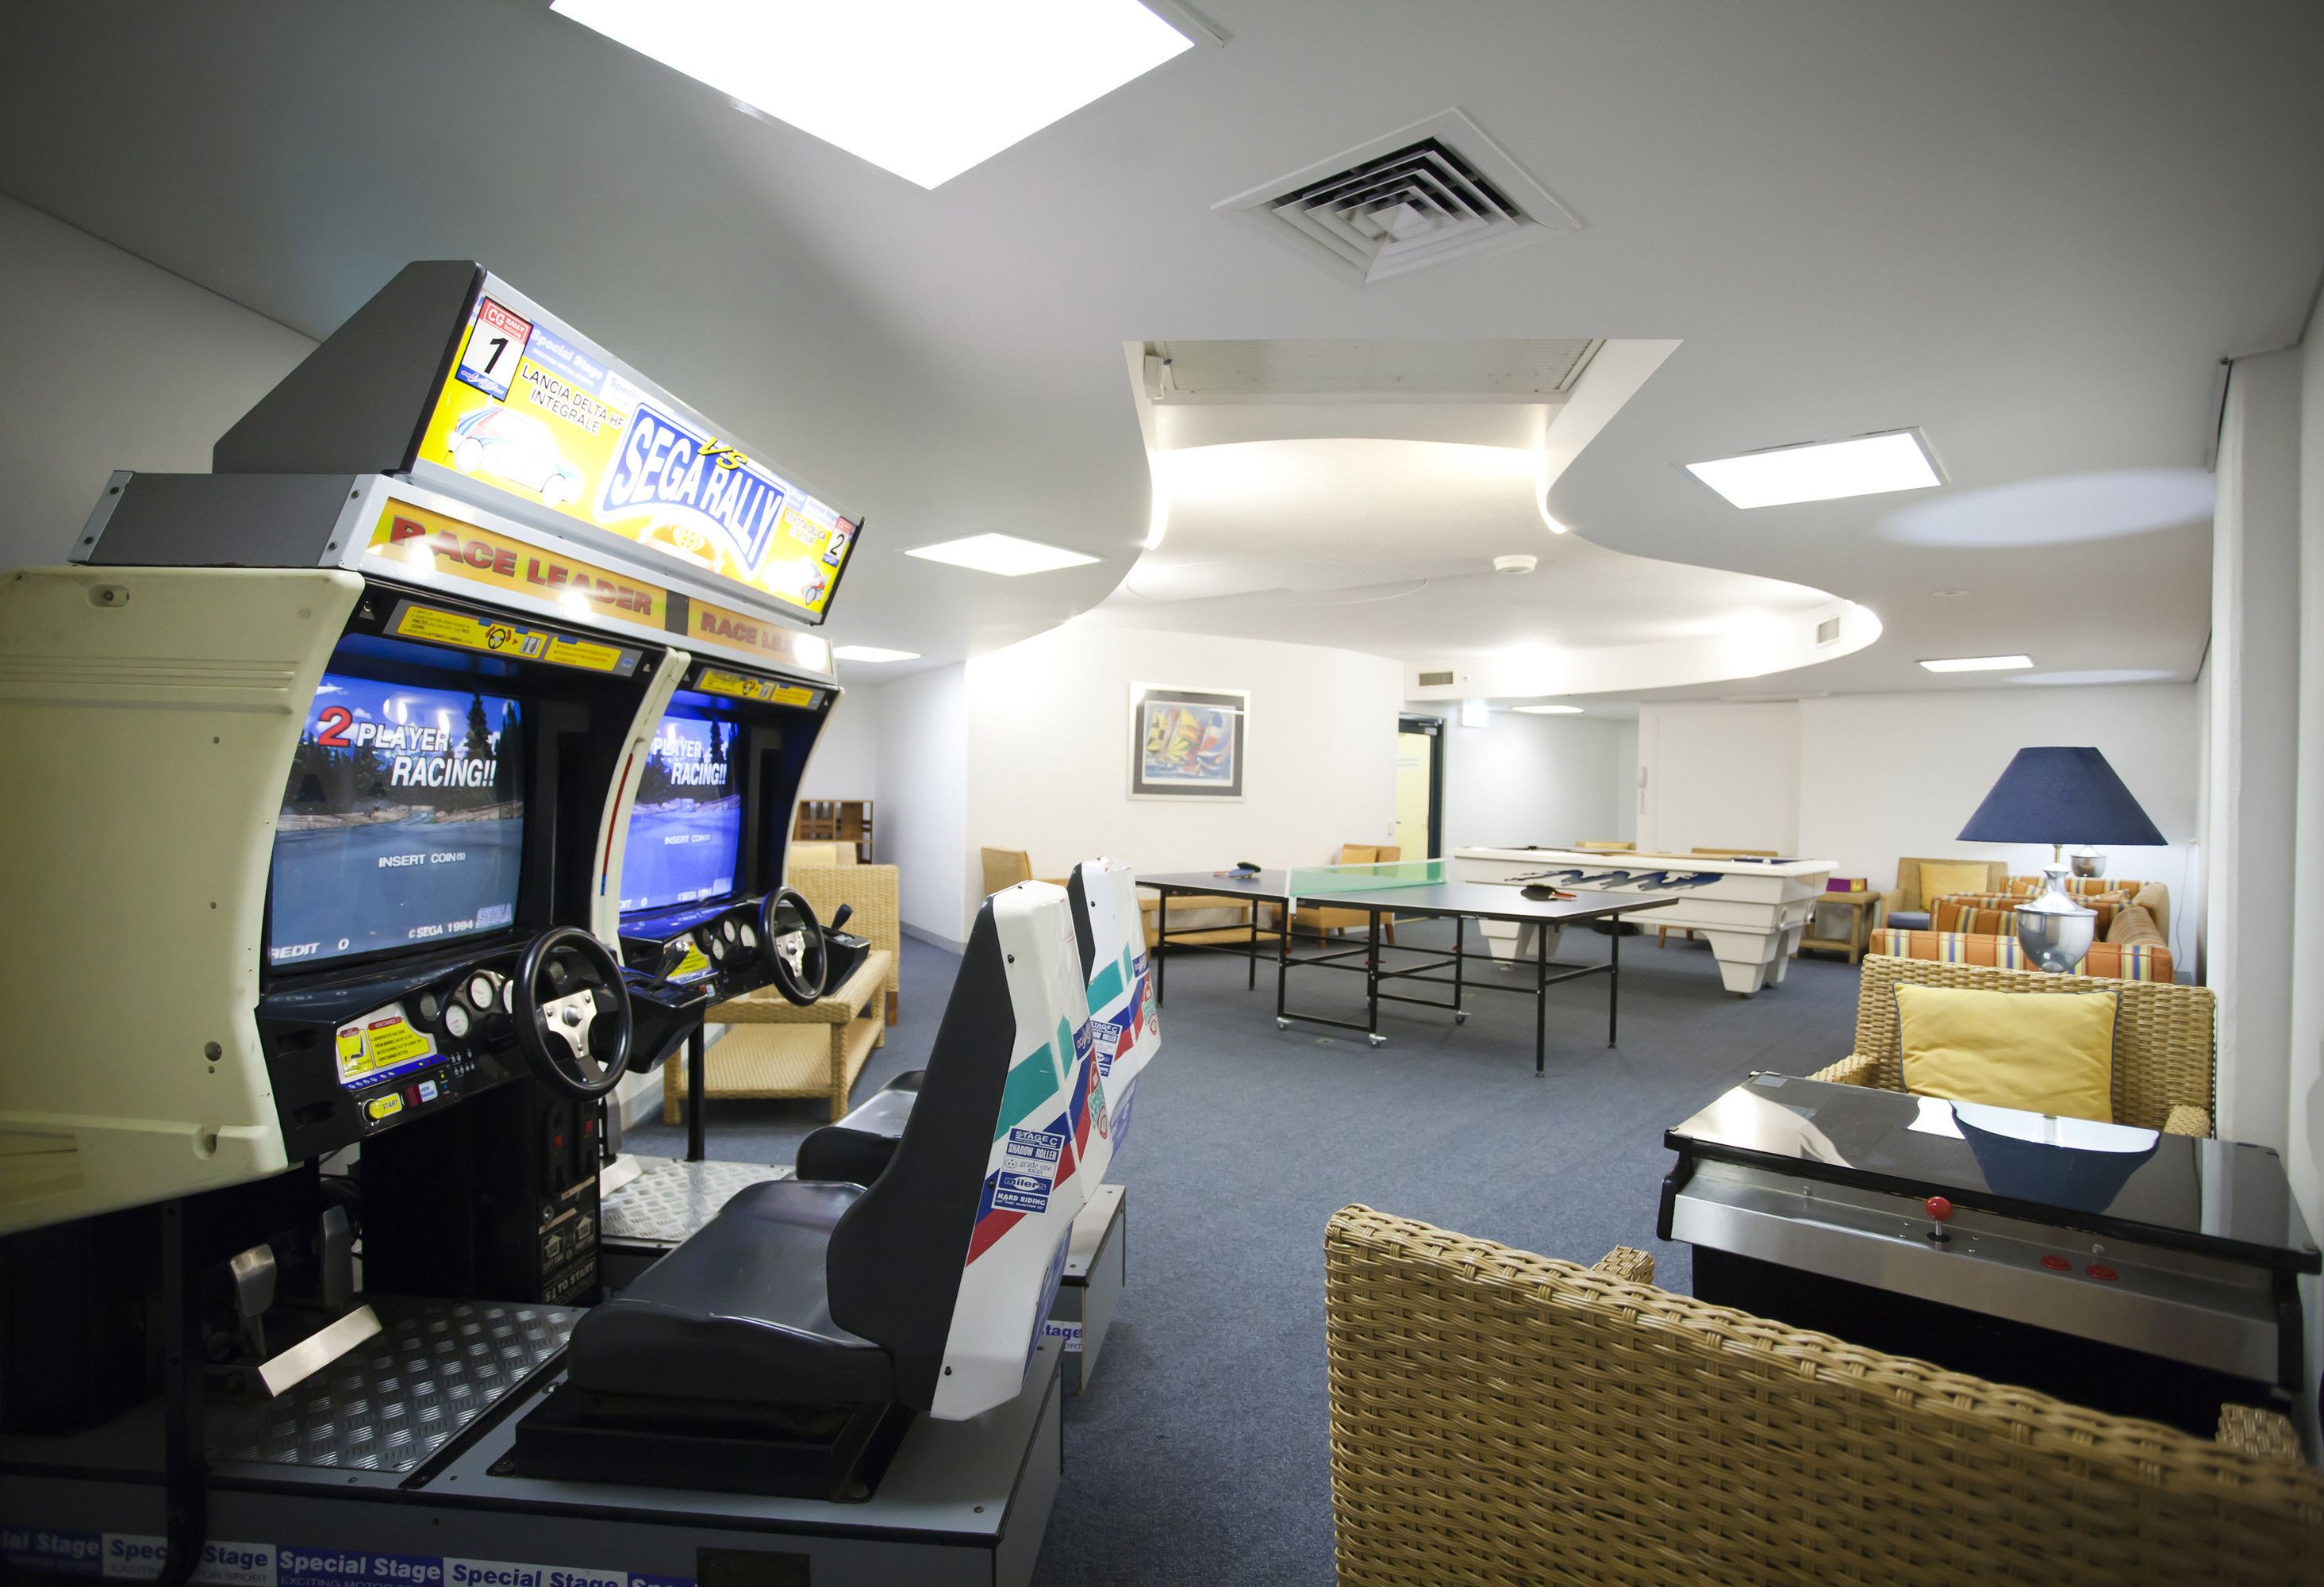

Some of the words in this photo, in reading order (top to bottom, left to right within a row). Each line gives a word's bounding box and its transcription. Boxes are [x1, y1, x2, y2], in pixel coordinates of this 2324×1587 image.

[488, 308, 506, 326] CG
[489, 337, 509, 375] 1
[531, 329, 574, 362] Special
[573, 355, 604, 380] Stage
[521, 364, 570, 401] LANCIA
[573, 394, 607, 421] DELTA
[609, 413, 624, 428] HF
[531, 389, 600, 433] INTEGRALE
[697, 436, 748, 470] VS
[610, 417, 706, 506] SEGA
[700, 466, 783, 565] RALLY
[829, 532, 845, 556] 2
[390, 514, 517, 578] RACE
[526, 557, 652, 617] LEADER
[700, 611, 759, 645] RACE
[317, 705, 353, 748] 2
[357, 721, 451, 753] PLAYER
[651, 736, 702, 759] PLAYER
[390, 755, 497, 789] RACING!!
[670, 762, 728, 786] RACING!!
[378, 854, 426, 869] INSERT
[447, 920, 474, 933] 1994
[476, 903, 513, 928] SEGA
[271, 943, 321, 962] REDIT
[337, 938, 350, 951] 0
[1015, 1130, 1049, 1143] STAGE
[1049, 1137, 1058, 1146] C
[1008, 1143, 1034, 1157] SHADOW
[1035, 1148, 1058, 1161] ROLLER
[1019, 1159, 1039, 1170] grade
[1004, 1177, 1047, 1190] milers
[997, 1193, 1019, 1201] HARD
[1020, 1196, 1046, 1206] RIDING
[1042, 1324, 1082, 1341] tage
[35, 1532, 101, 1559] Stage
[110, 1539, 167, 1562] Spec
[203, 1546, 268, 1571] Stage
[278, 1550, 367, 1575] Special
[373, 1558, 441, 1584] Stage
[452, 1564, 542, 1587] Special
[225, 1572, 267, 1582] SPORT
